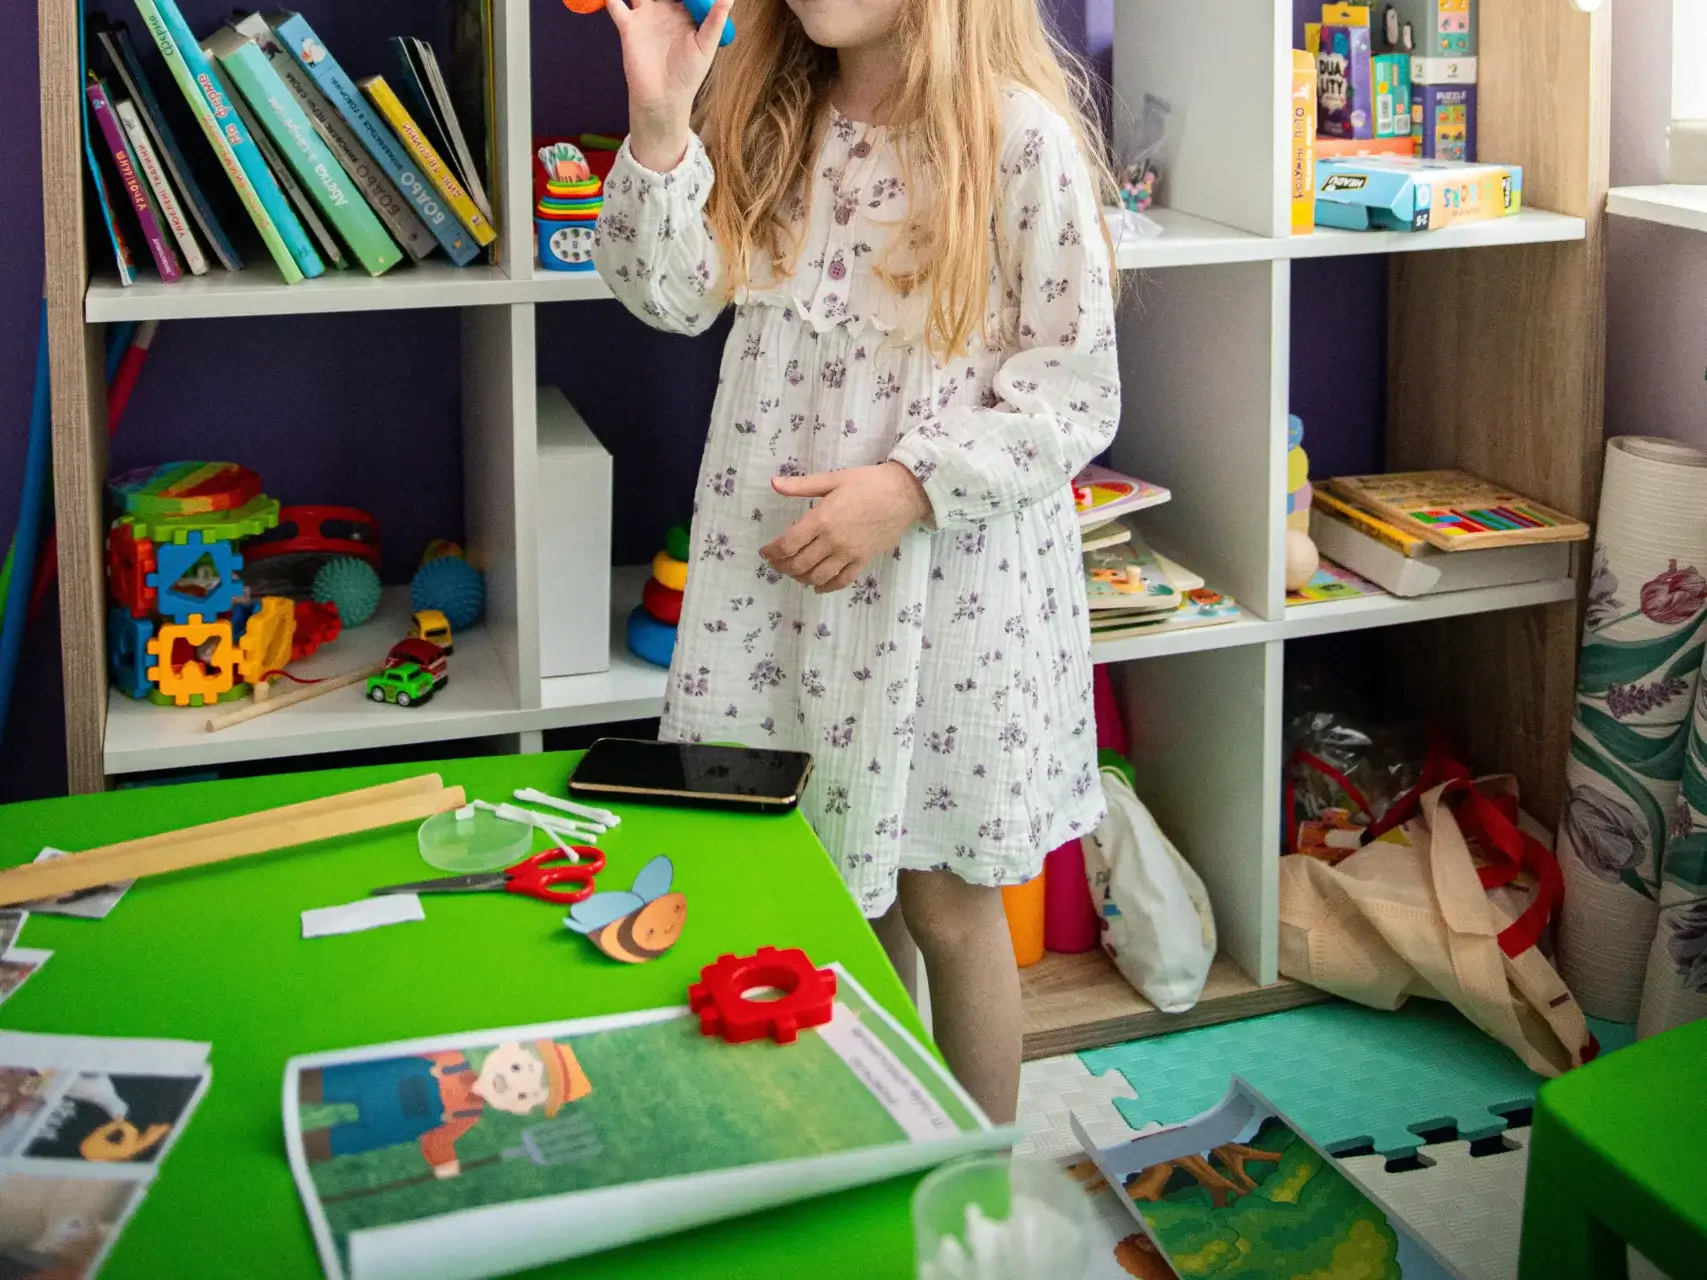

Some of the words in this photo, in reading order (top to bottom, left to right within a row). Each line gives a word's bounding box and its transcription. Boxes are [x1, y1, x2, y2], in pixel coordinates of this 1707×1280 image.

[195, 71, 231, 119] ферме
[222, 123, 242, 146] На
[115, 150, 147, 211] ШНУРІВОЧКА
[398, 169, 445, 225] БОДЬО
